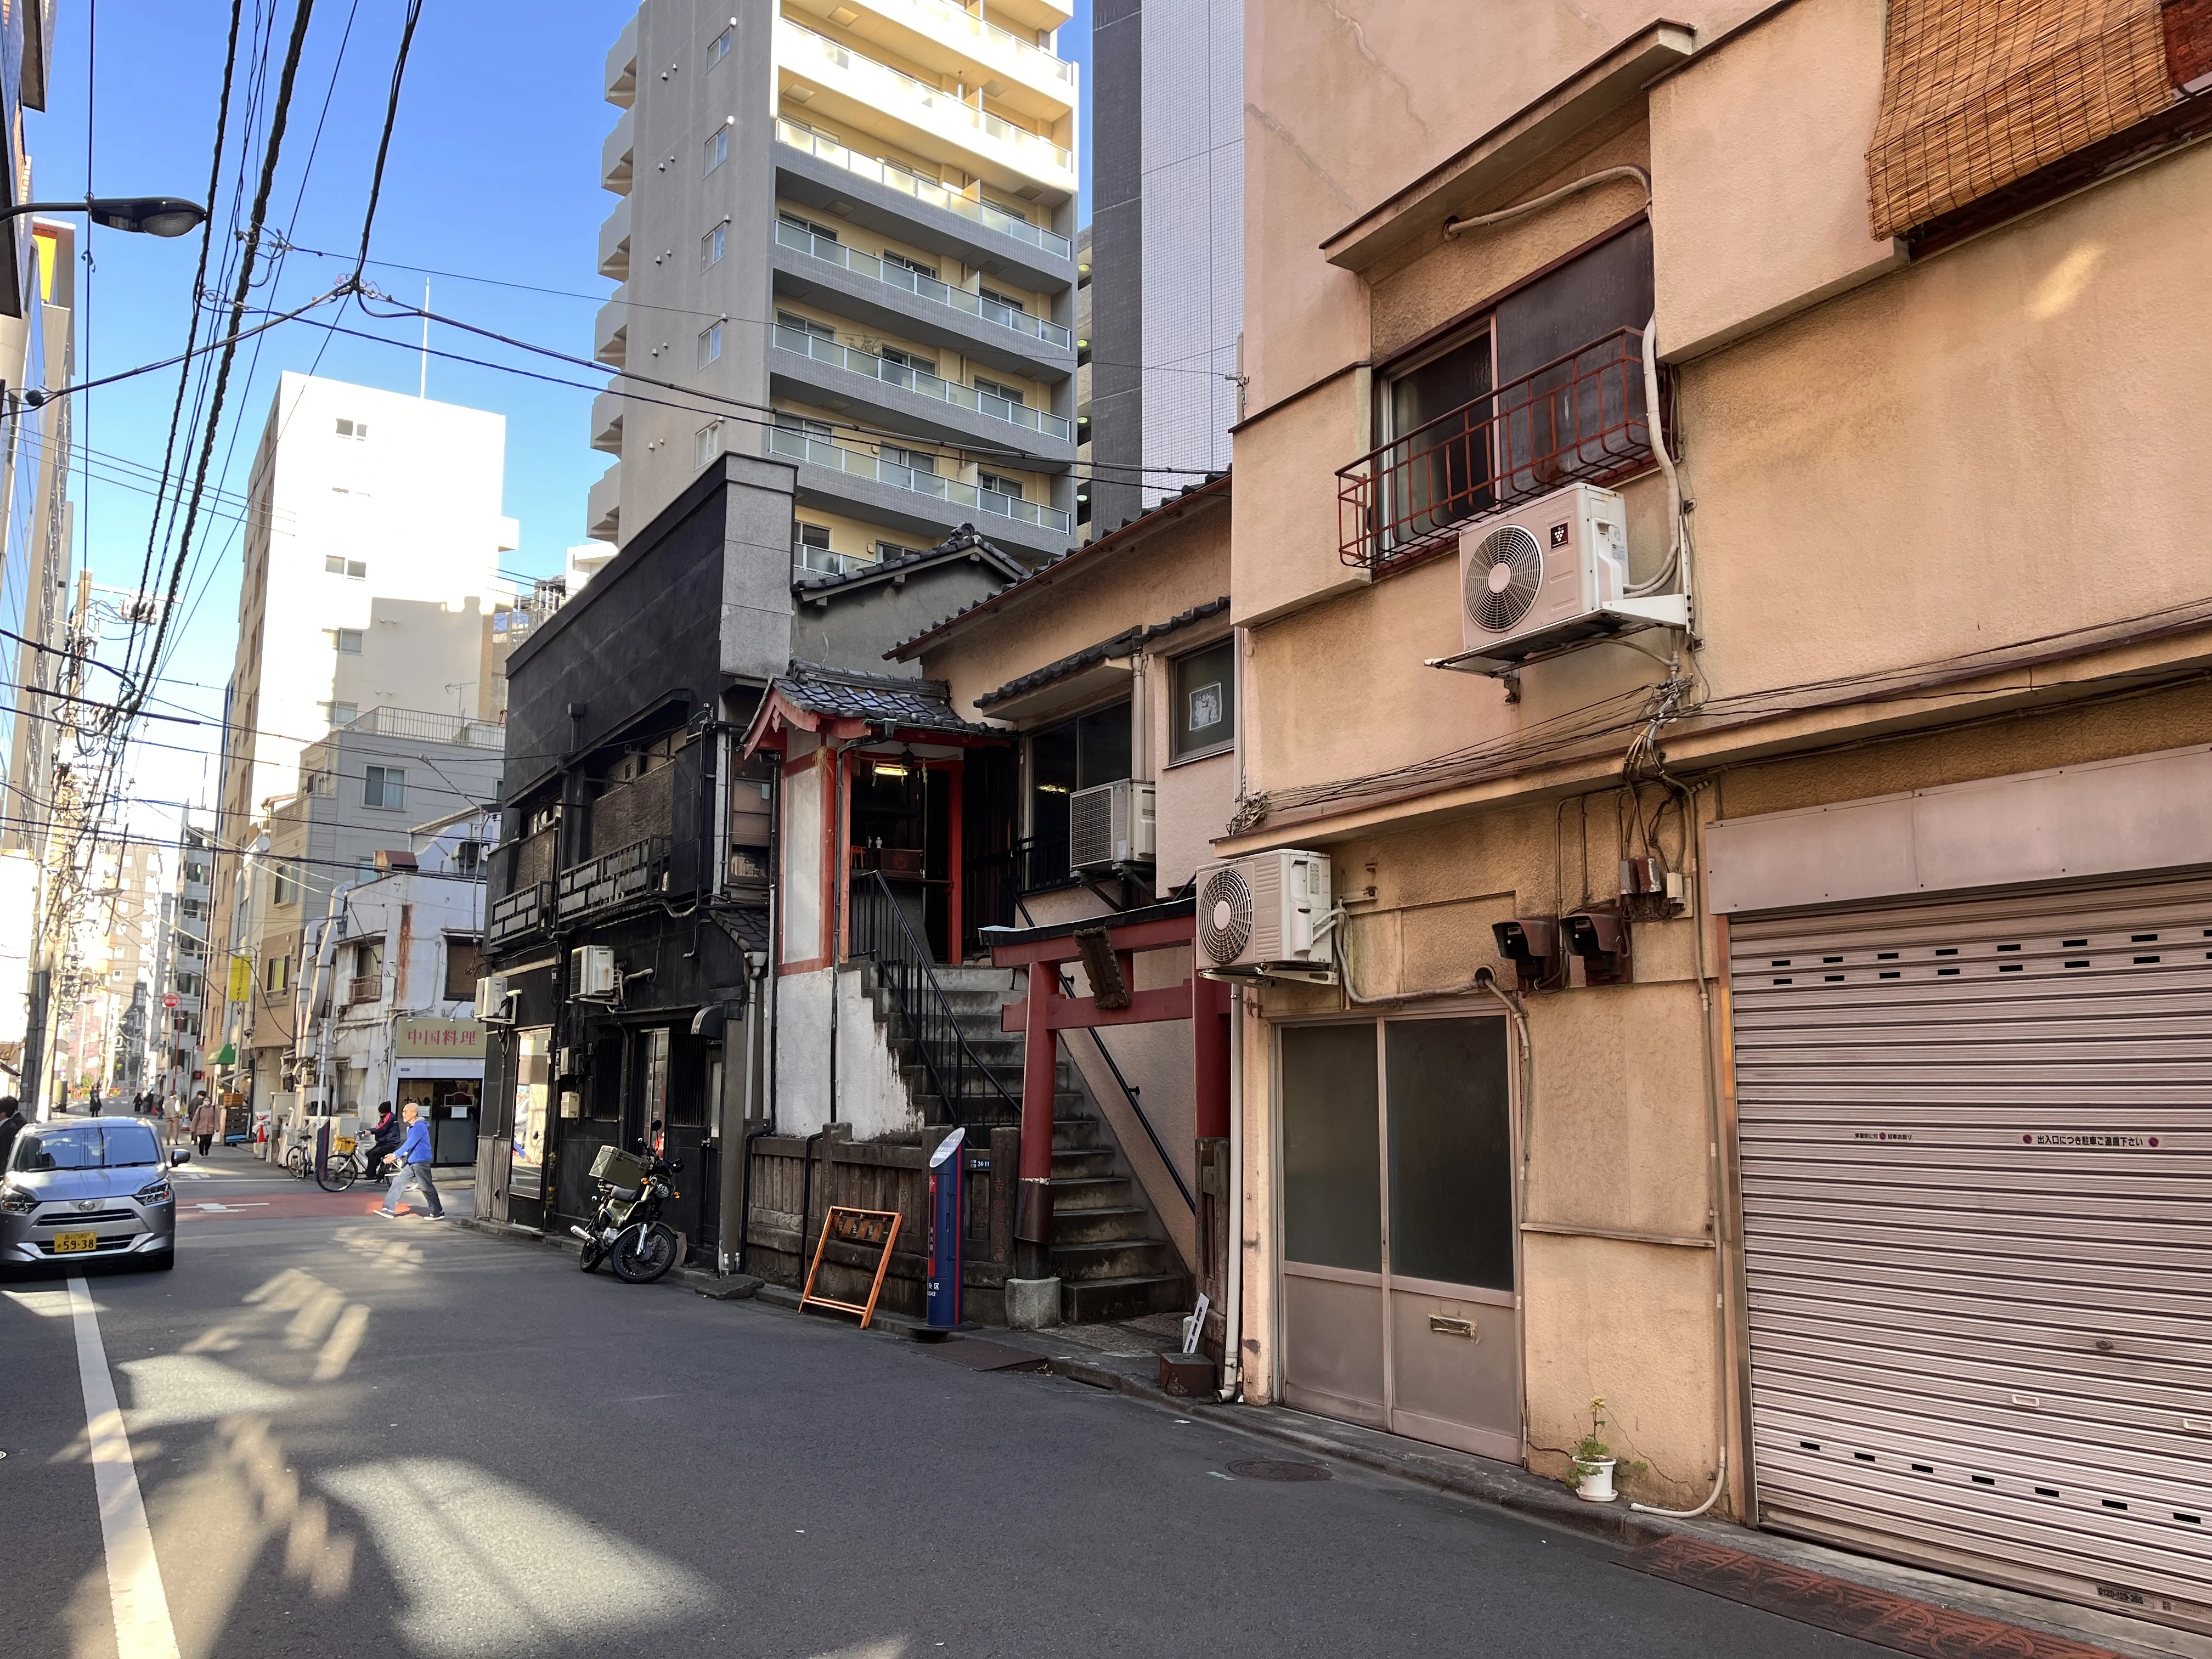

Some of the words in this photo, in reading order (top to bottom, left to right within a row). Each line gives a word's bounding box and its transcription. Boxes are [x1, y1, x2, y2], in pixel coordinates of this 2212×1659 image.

[408, 1029, 476, 1045] 中国料理
[2037, 1135, 2143, 1147] 出入口につき駐車ご遠慮下さい
[64, 1239, 94, 1250] 59-38
